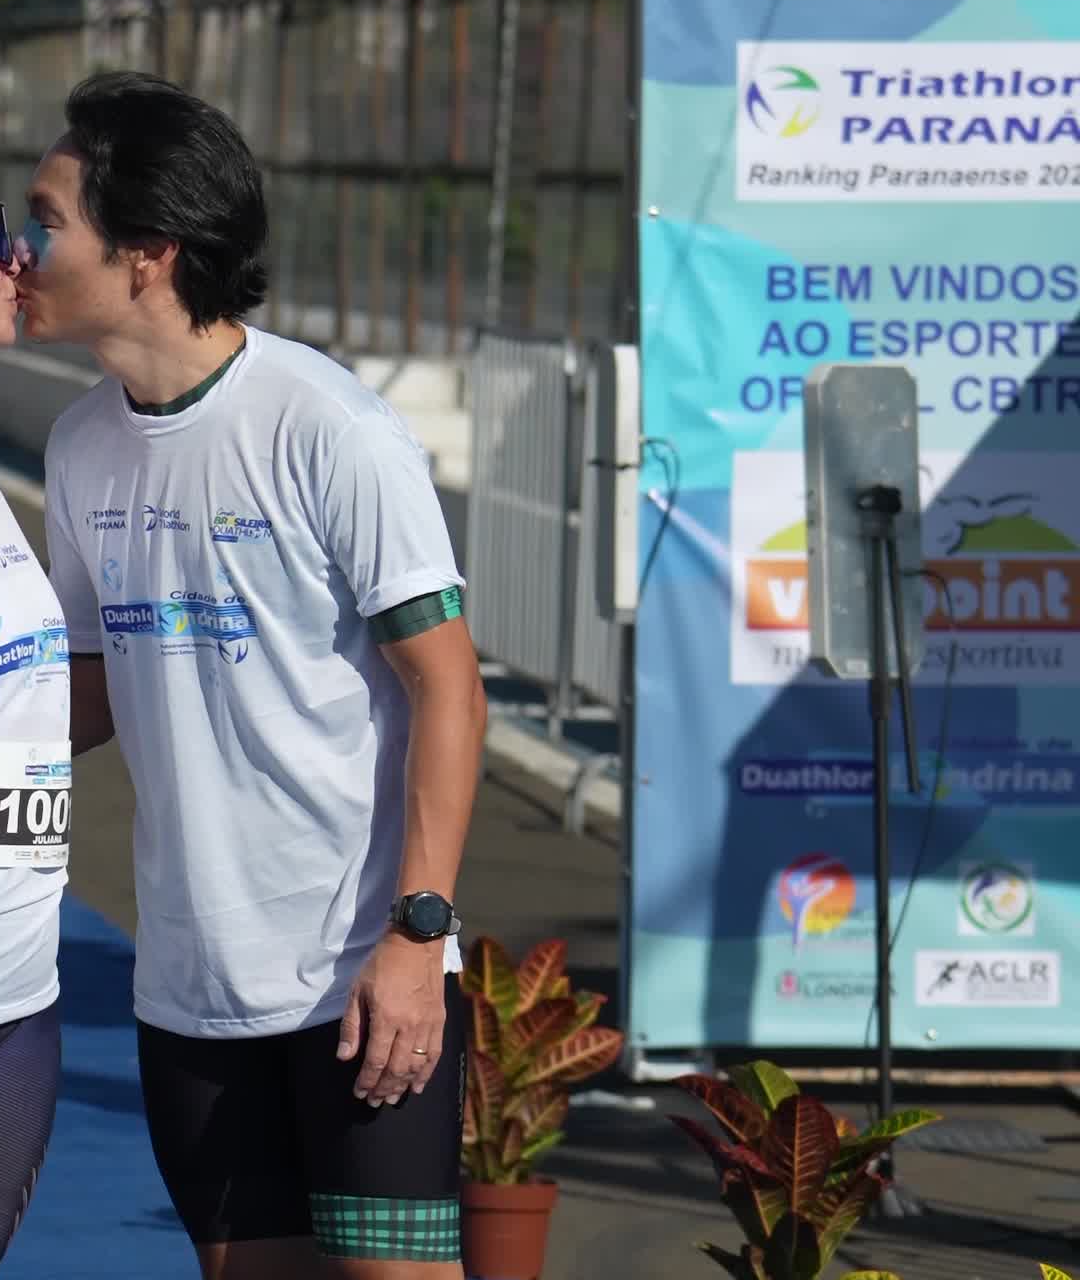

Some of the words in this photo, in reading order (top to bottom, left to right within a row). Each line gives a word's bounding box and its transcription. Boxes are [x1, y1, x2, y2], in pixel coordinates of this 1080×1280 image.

[841, 110, 1080, 144] PARANÁ
[748, 164, 860, 192] Ranking
[869, 164, 1029, 187] Paranaense
[766, 265, 873, 302] BEM
[890, 264, 1080, 303] VINDOS
[758, 321, 830, 358] AO
[847, 320, 1080, 358] ESPORTE
[0, 789, 71, 835] 100
[967, 961, 1049, 984] ACLR
